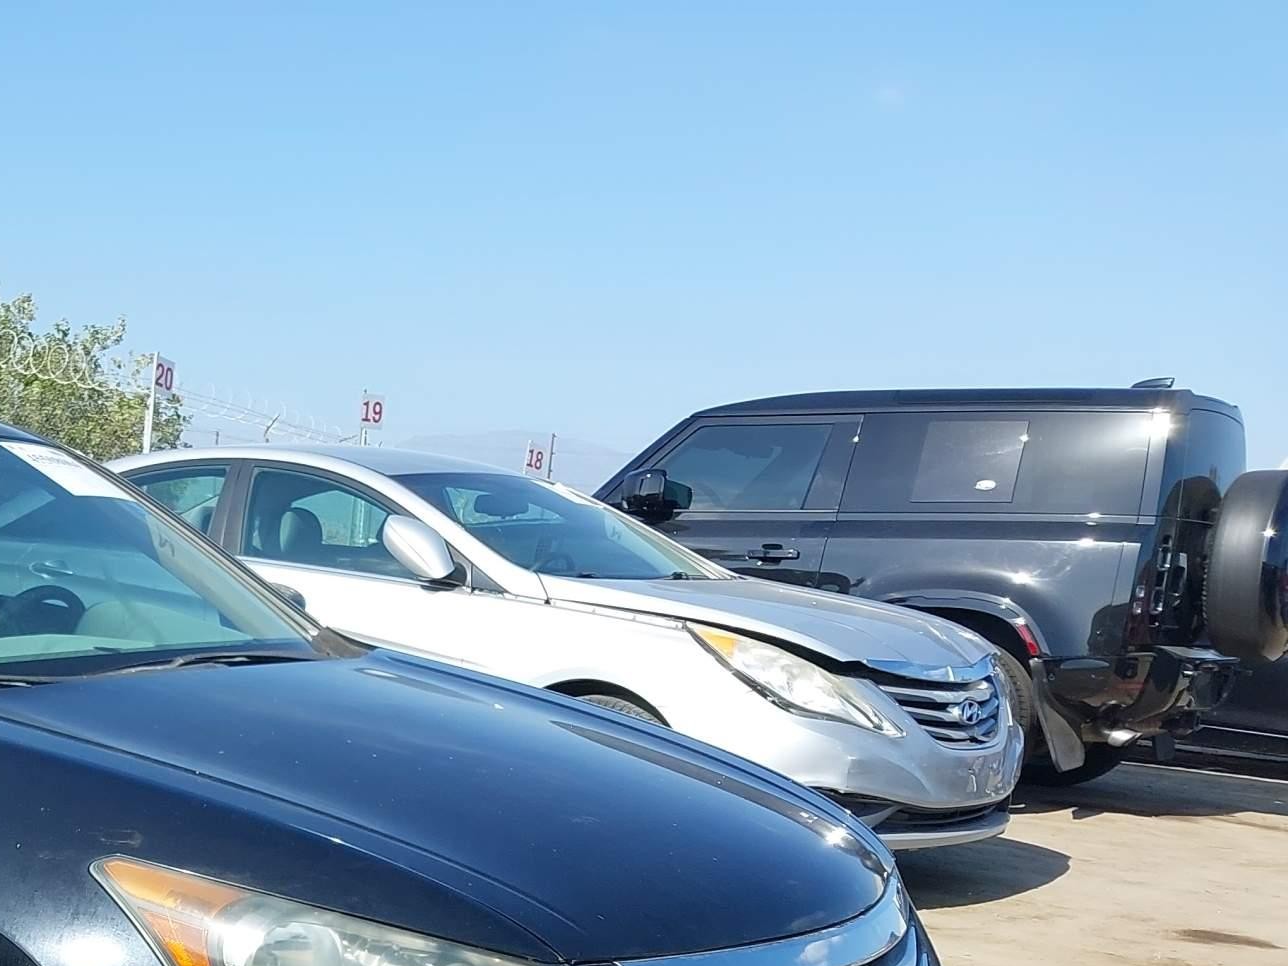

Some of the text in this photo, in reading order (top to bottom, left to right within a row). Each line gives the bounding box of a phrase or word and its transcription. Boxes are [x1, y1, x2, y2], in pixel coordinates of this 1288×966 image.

[155, 362, 174, 391] 20
[361, 399, 383, 424] 19
[525, 448, 544, 470] 18
